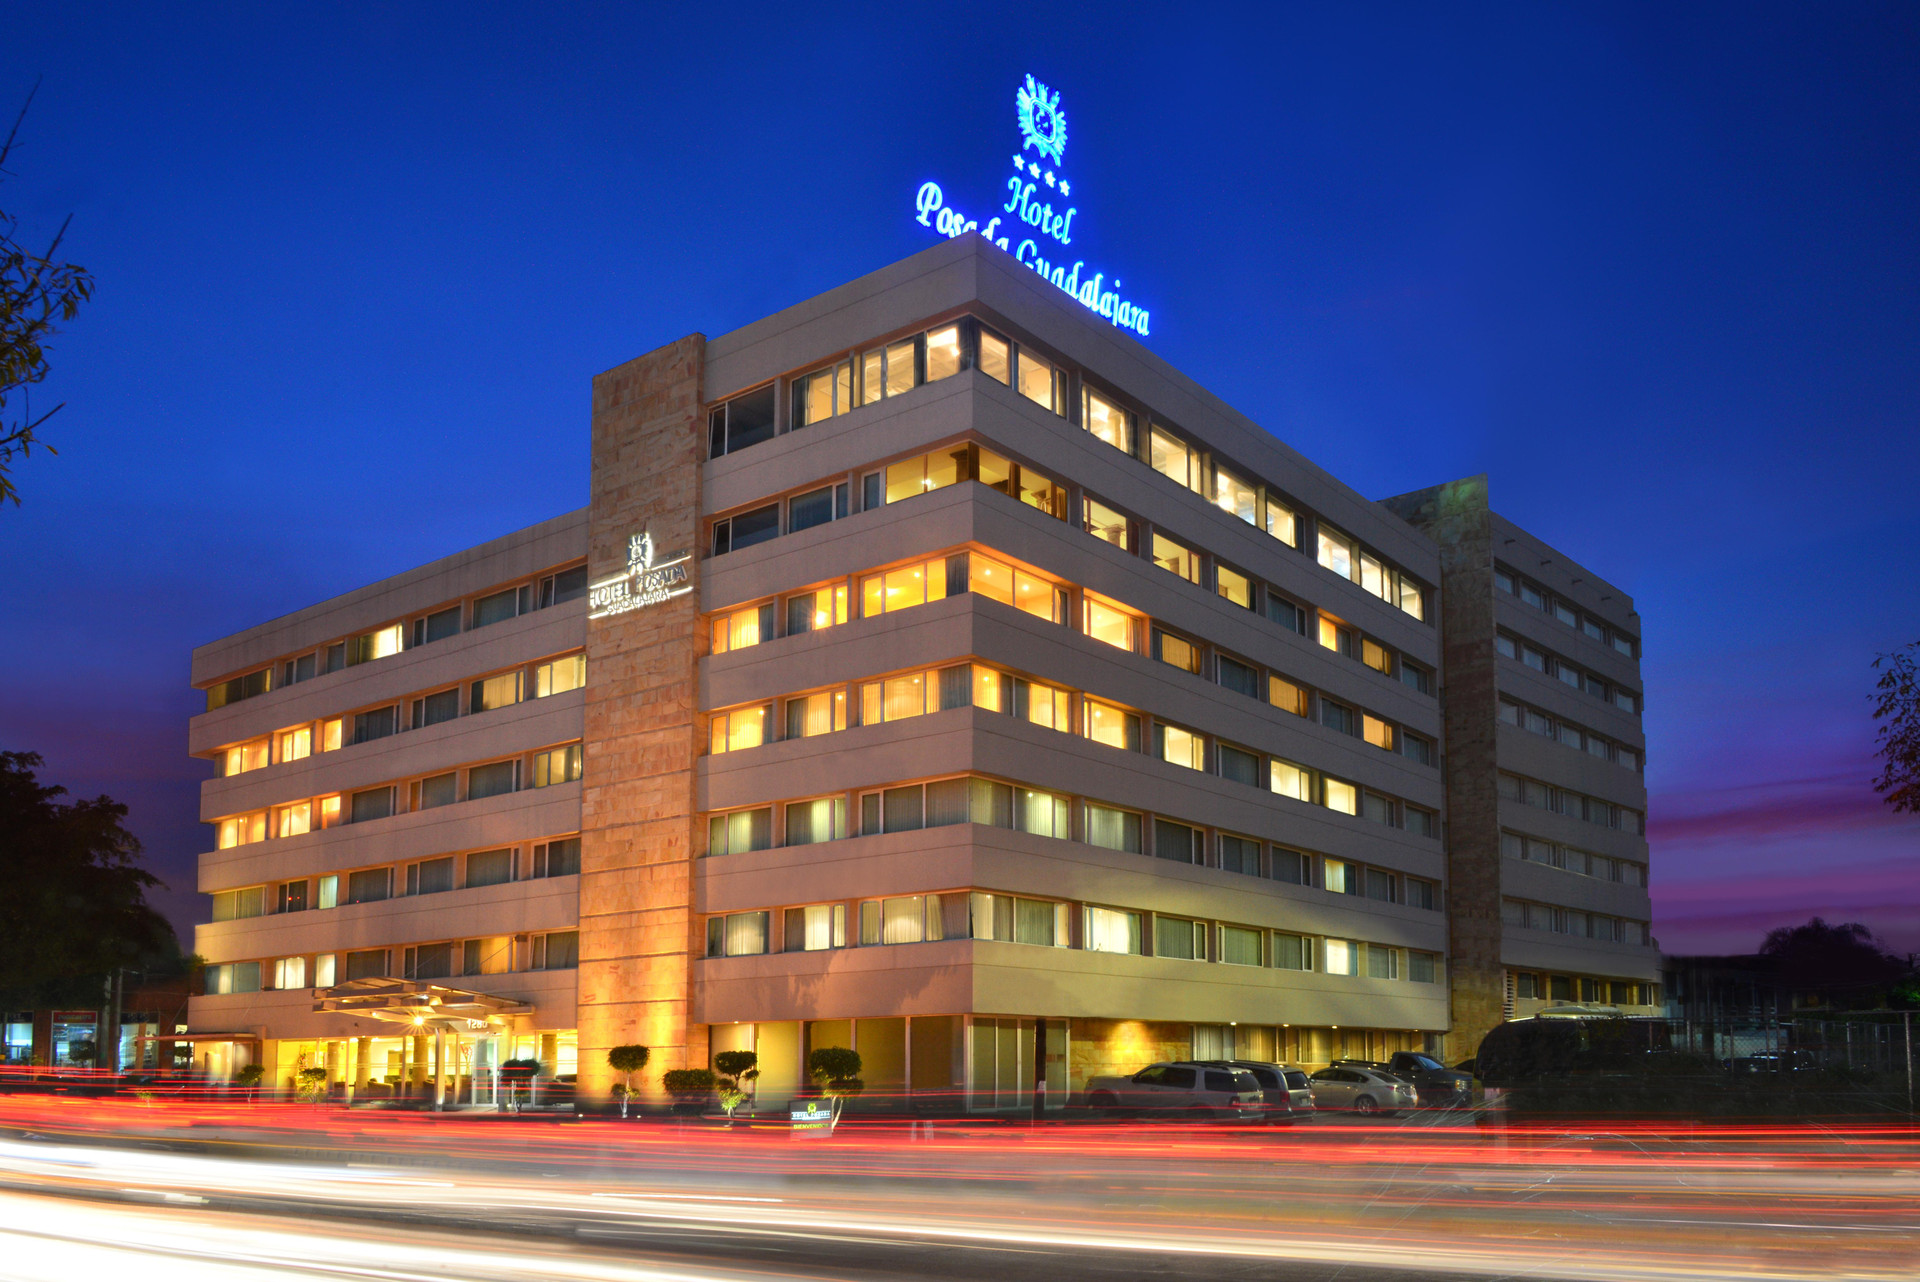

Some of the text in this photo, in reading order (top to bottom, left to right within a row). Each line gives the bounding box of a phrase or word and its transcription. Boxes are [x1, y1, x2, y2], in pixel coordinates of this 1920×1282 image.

[1003, 176, 1077, 245] Hotel
[1016, 238, 1150, 337] Guadalajara
[589, 565, 688, 610] HOTEL POSADA
[607, 588, 670, 615] GUADALAJARA
[466, 1018, 488, 1030] 1280
